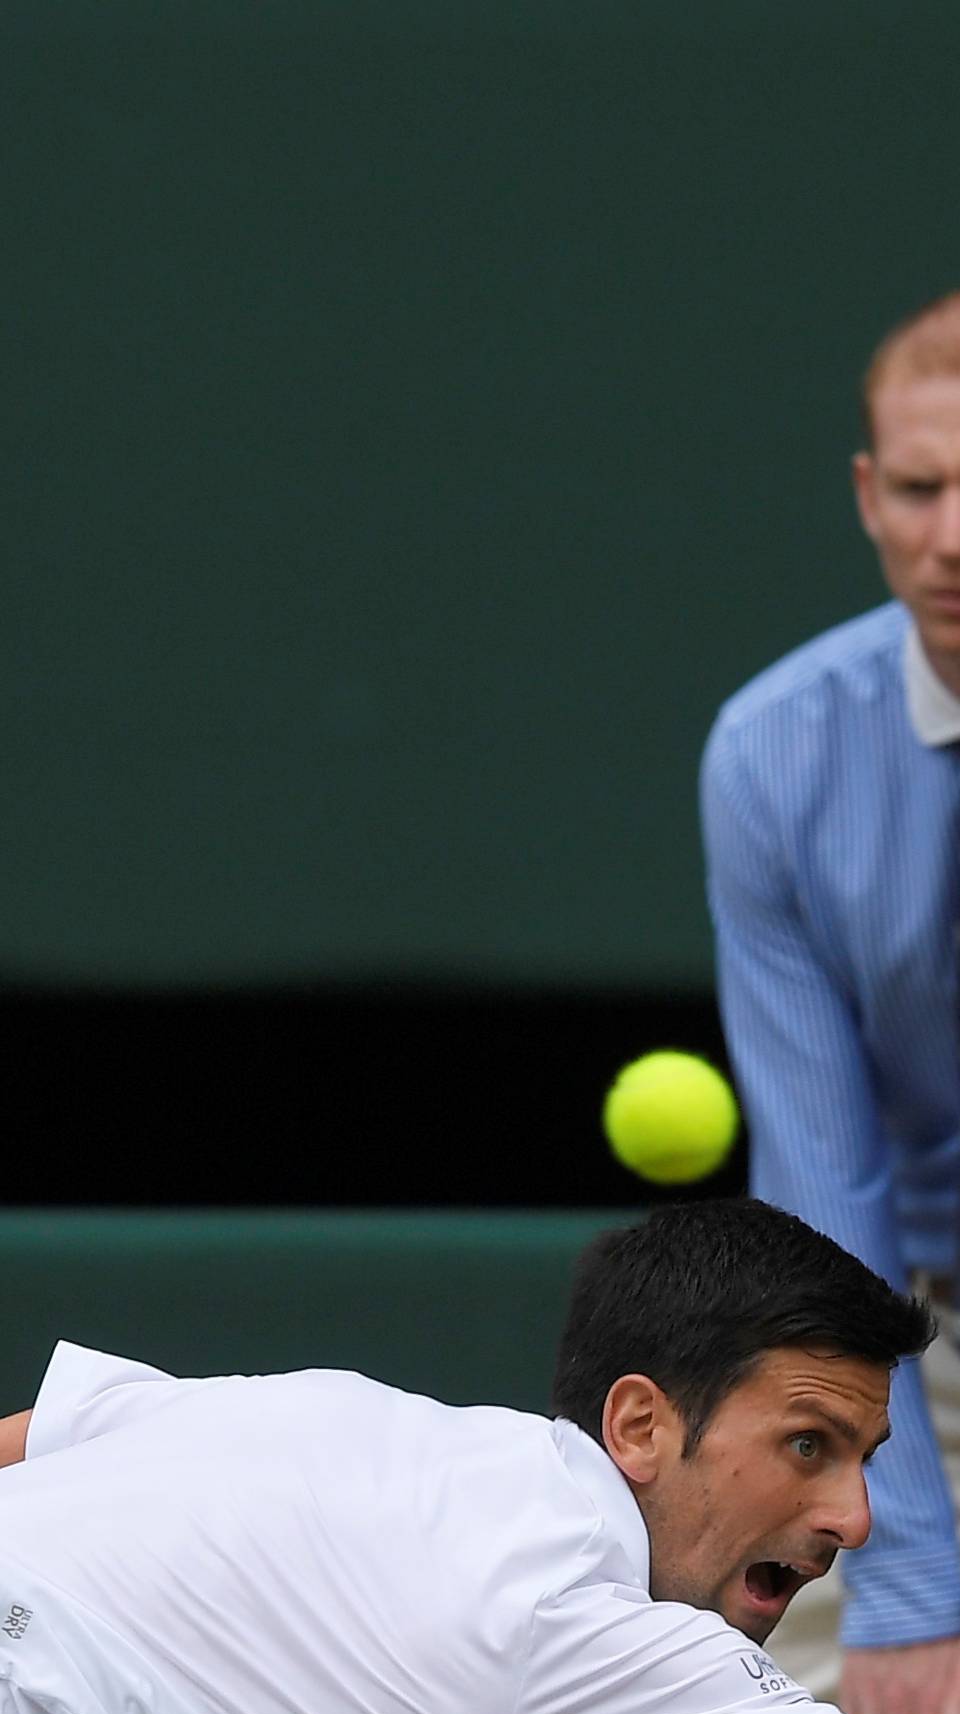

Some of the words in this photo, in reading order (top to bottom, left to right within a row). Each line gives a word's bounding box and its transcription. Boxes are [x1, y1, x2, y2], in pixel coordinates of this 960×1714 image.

[1, 1605, 25, 1638] DRY
[13, 1609, 33, 1639] ULTRA
[760, 1677, 793, 1694] SOF
